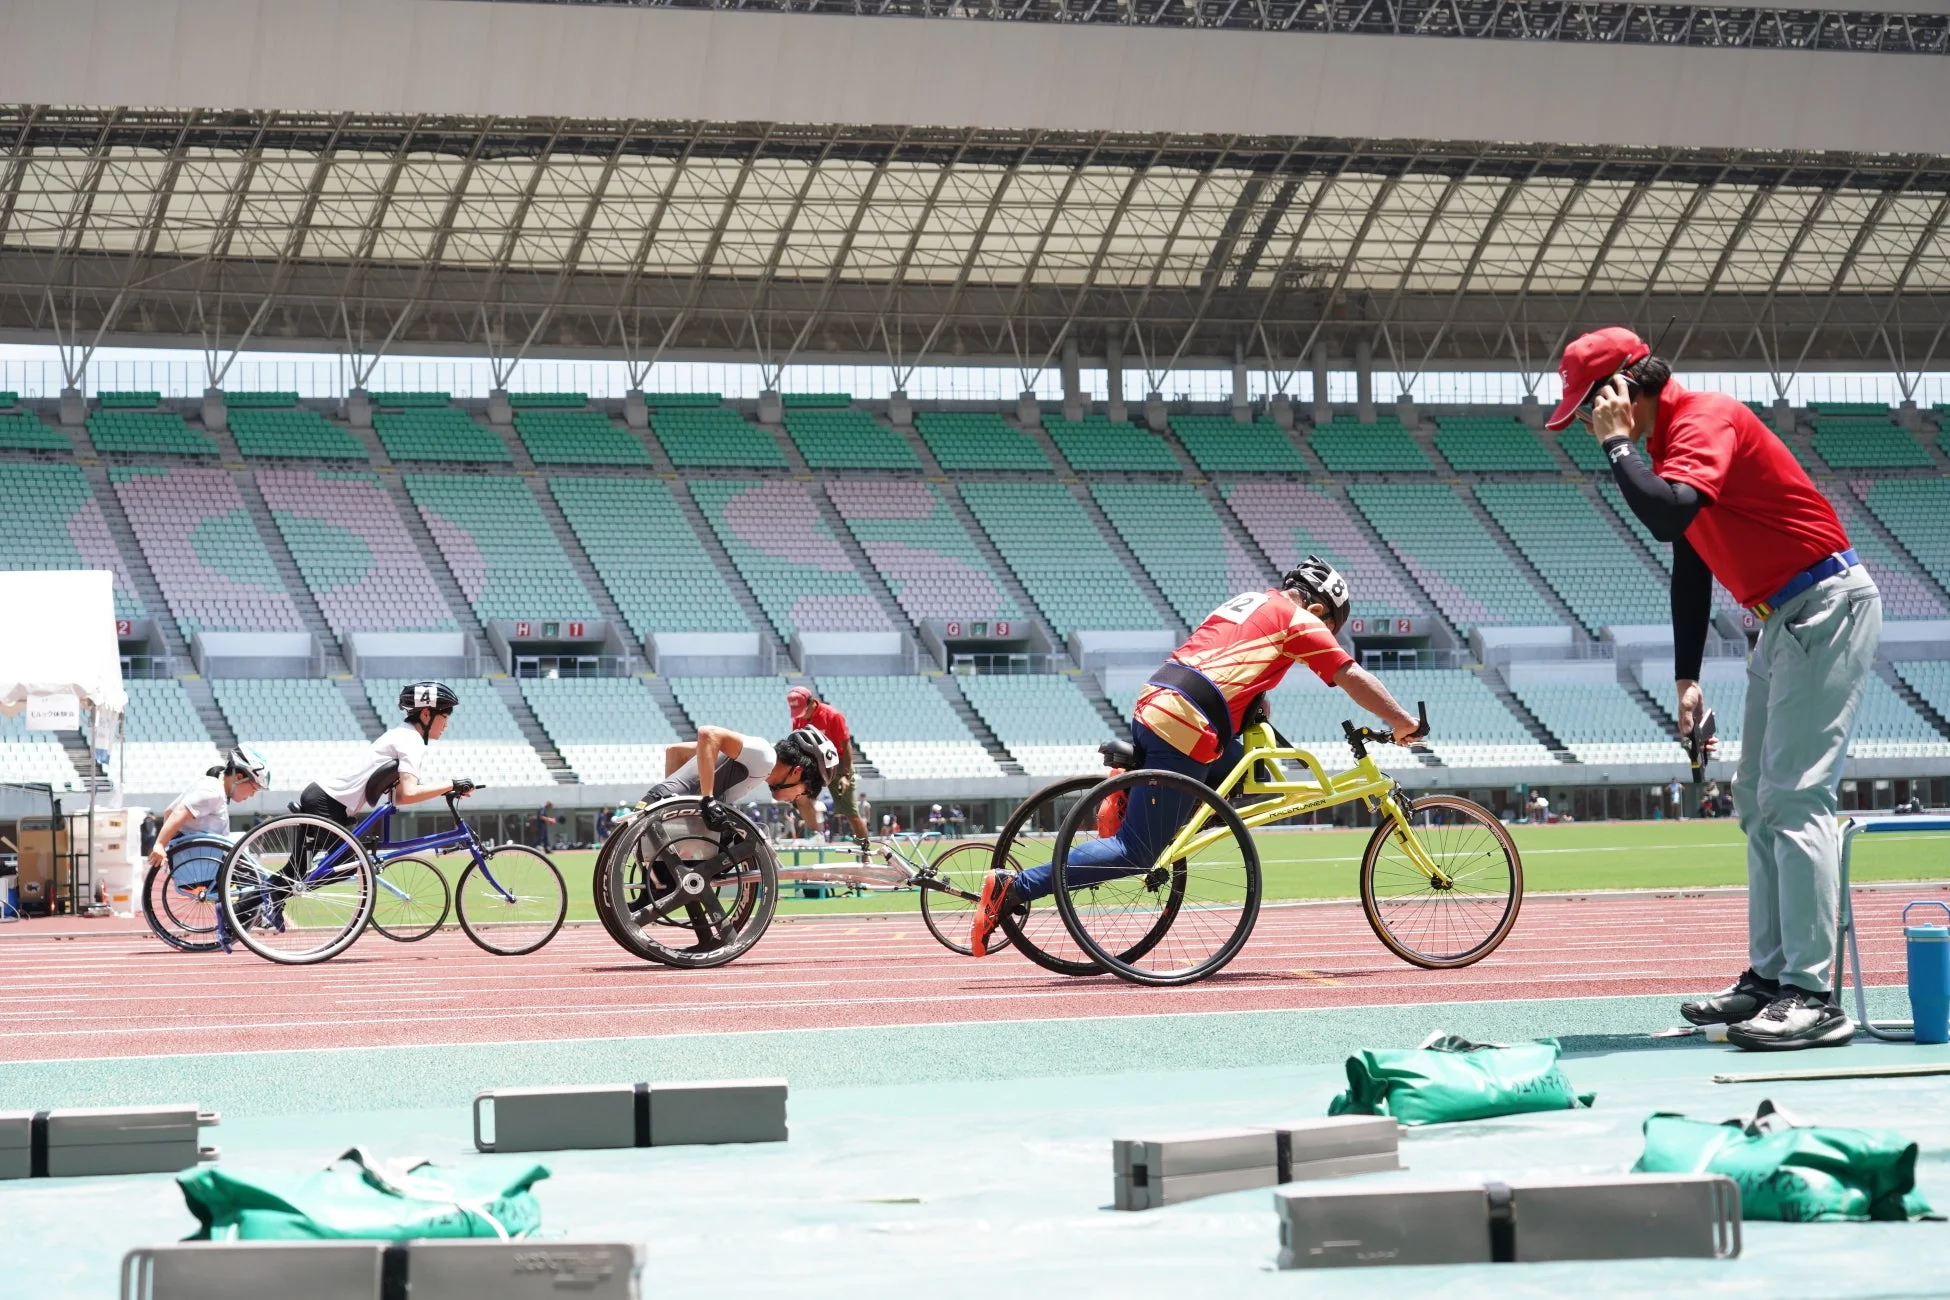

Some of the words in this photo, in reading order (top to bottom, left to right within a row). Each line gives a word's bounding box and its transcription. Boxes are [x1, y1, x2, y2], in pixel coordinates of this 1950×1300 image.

[1331, 578, 1345, 598] 8
[118, 620, 128, 635] 2
[517, 622, 529, 636] H
[948, 622, 959, 636] G
[998, 622, 1007, 636] 3
[1399, 619, 1409, 633] 2
[420, 689, 431, 705] 4
